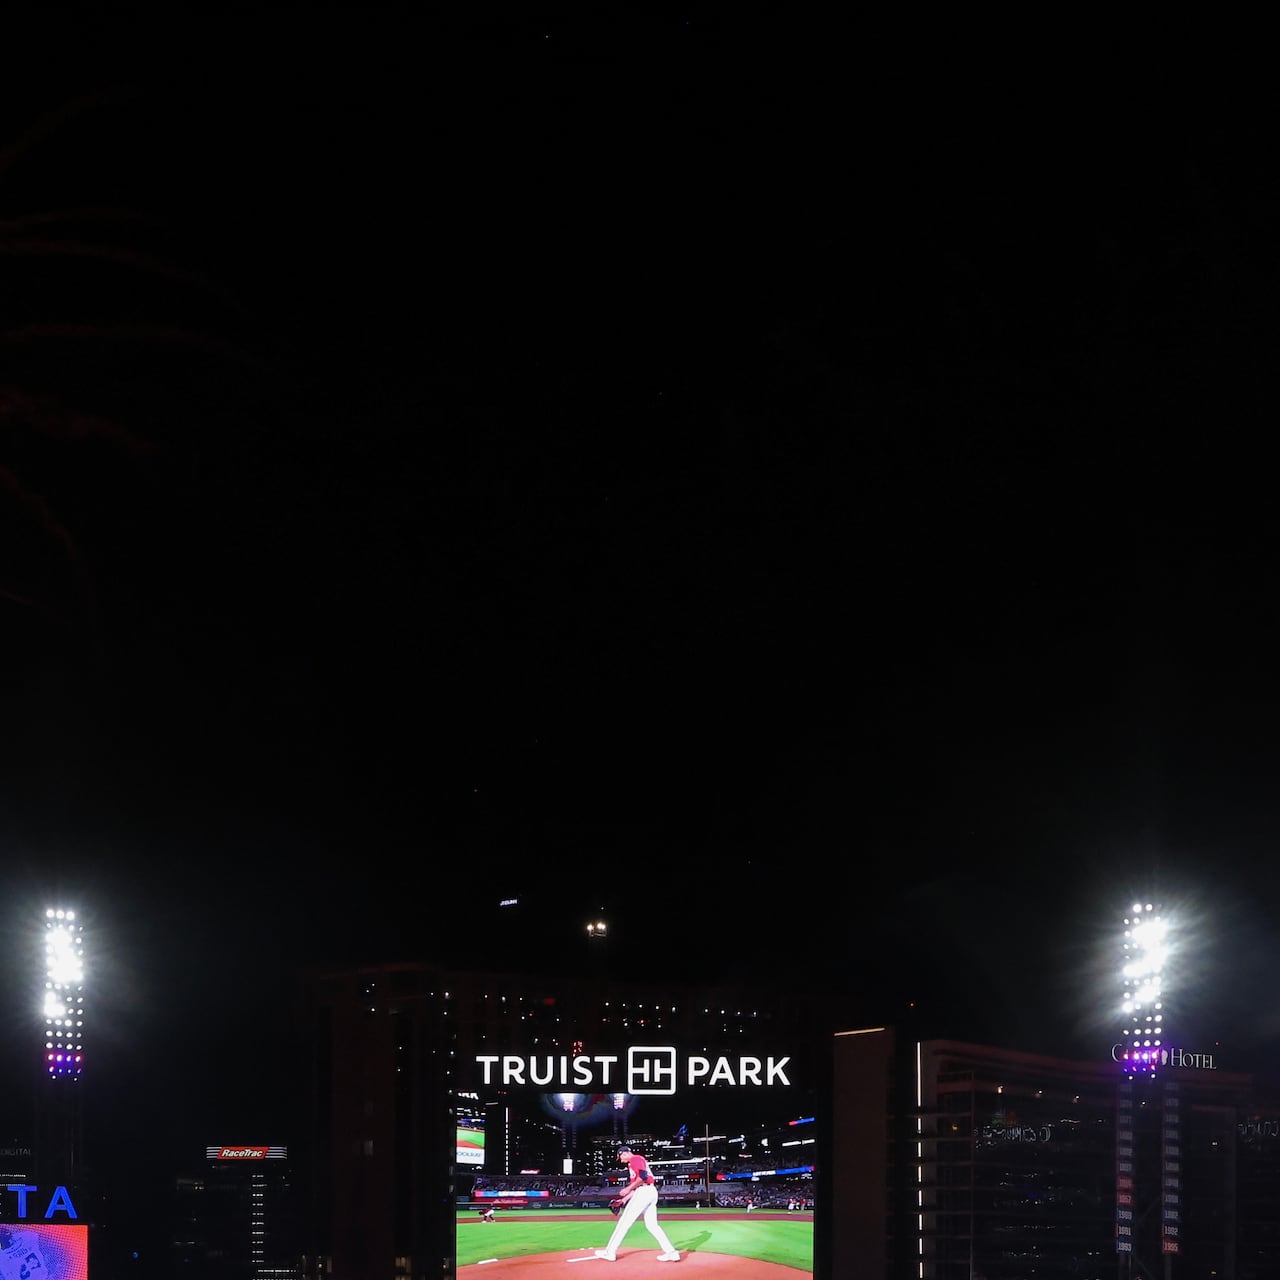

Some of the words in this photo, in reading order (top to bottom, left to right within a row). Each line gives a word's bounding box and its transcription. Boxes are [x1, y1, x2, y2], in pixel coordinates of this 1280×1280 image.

[476, 1055, 618, 1085] TRUIST
[688, 1056, 791, 1086] PARK
[222, 1149, 263, 1157] RaceTrac
